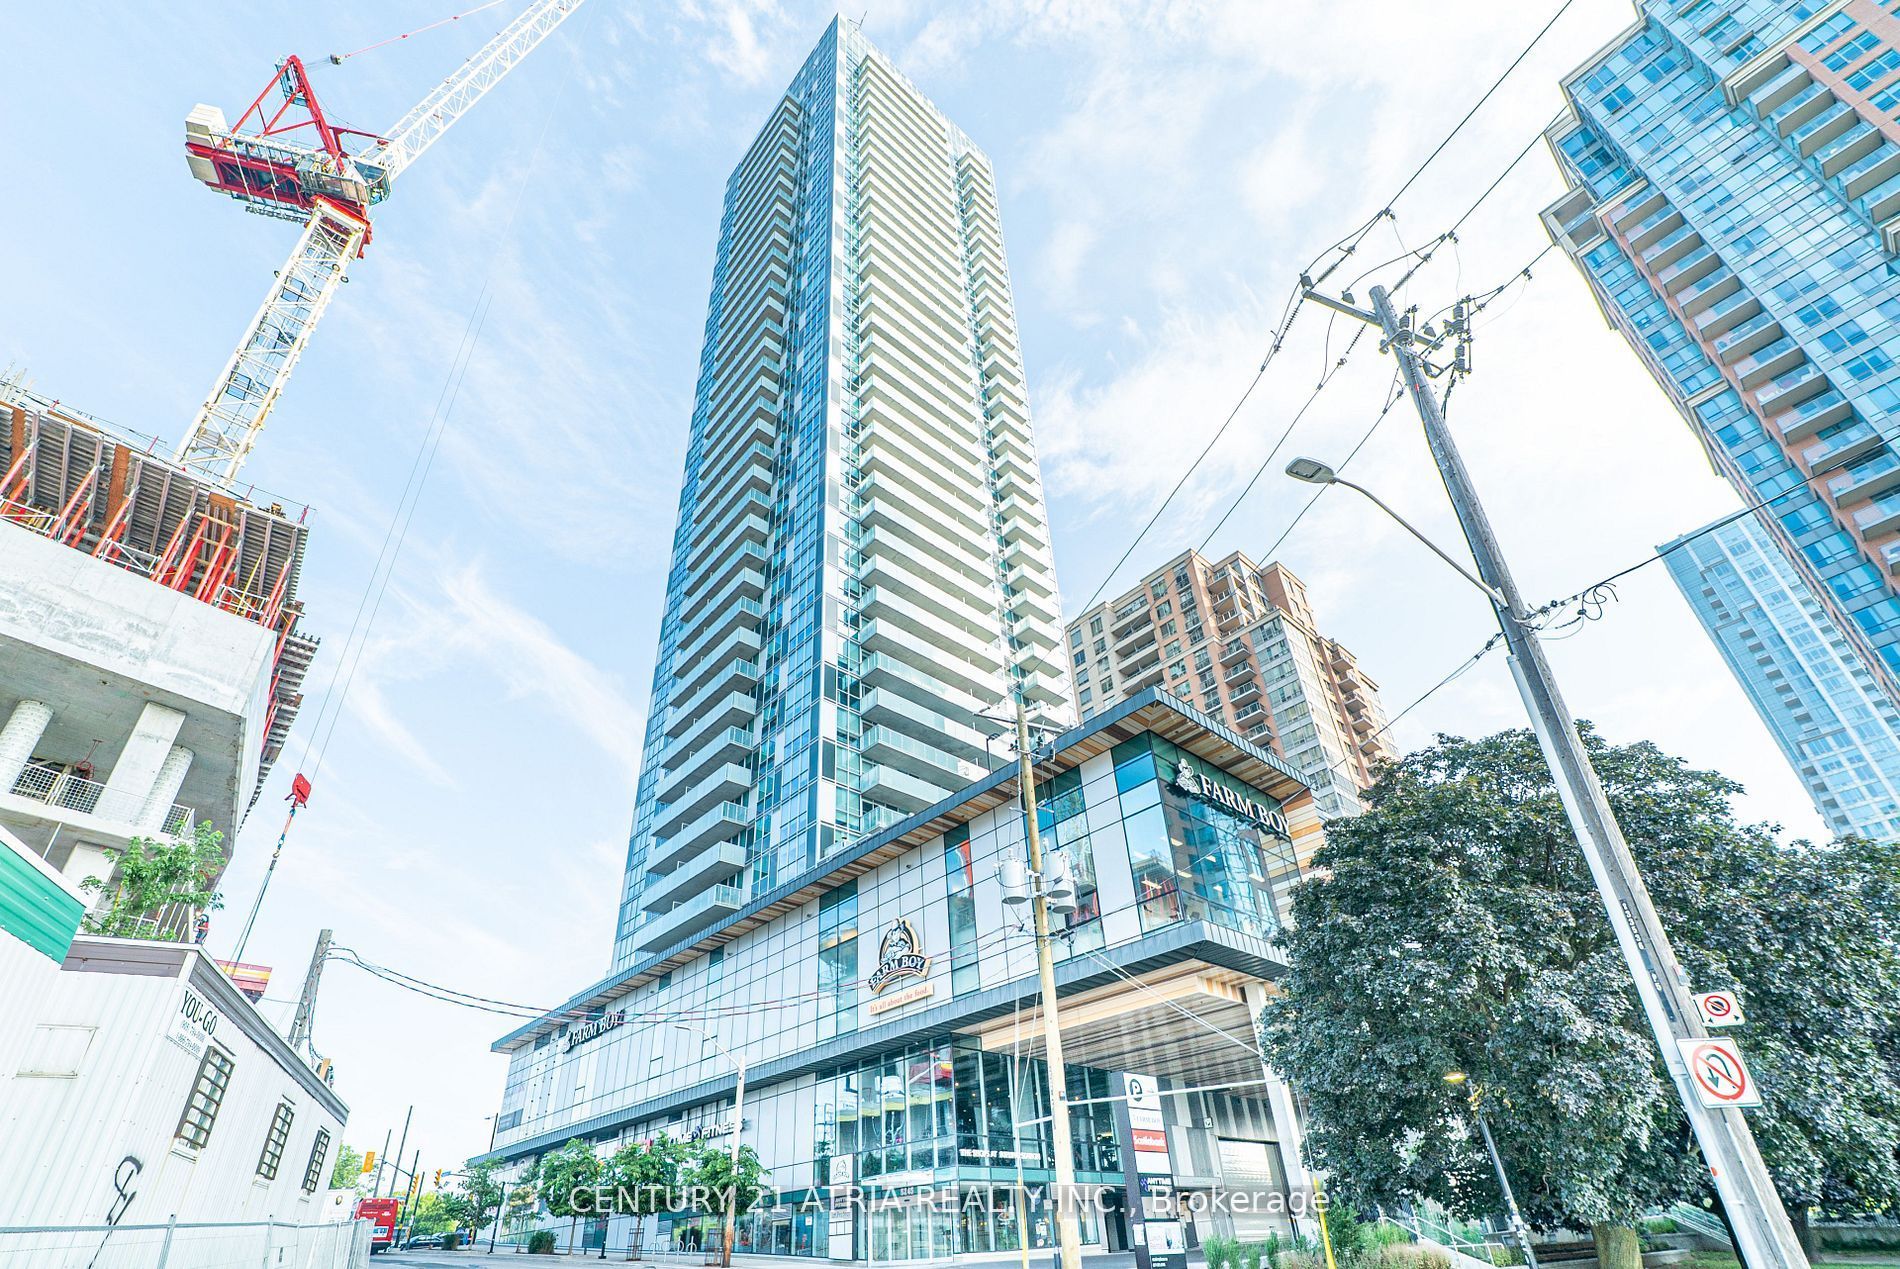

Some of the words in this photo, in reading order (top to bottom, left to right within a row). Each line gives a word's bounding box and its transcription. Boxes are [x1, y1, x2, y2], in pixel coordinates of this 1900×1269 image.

[1199, 773, 1255, 819] FARM
[1255, 803, 1290, 837] BOY
[870, 959, 900, 987] FARM
[901, 956, 925, 970] BOY
[571, 1021, 599, 1046] FARM
[599, 1012, 623, 1034] BOY
